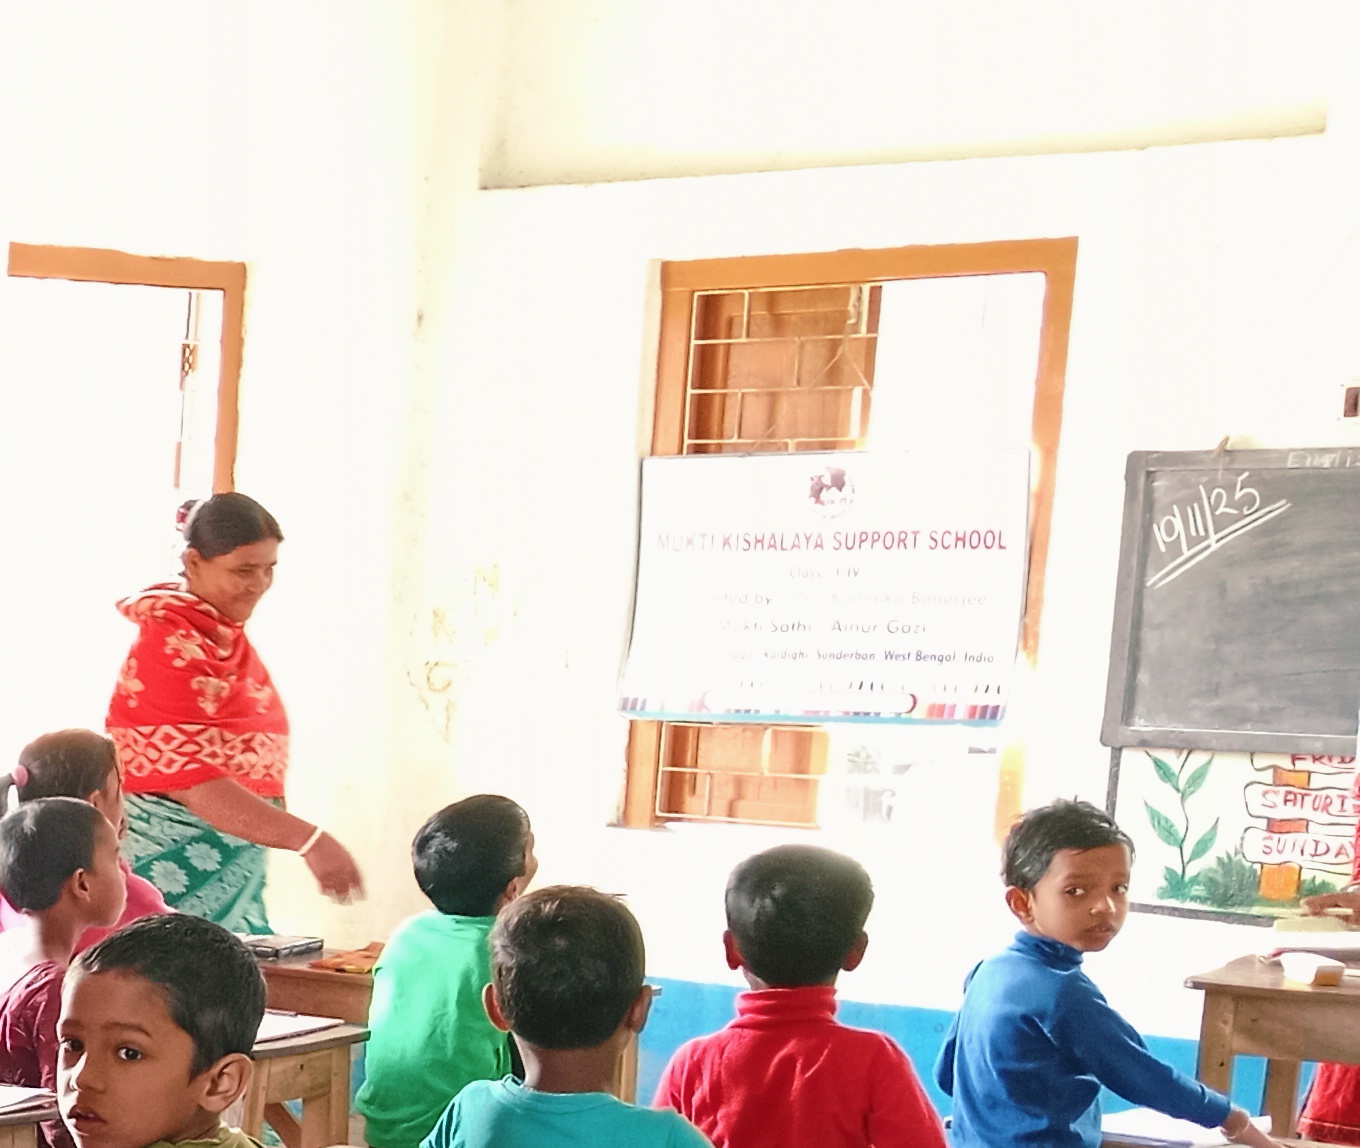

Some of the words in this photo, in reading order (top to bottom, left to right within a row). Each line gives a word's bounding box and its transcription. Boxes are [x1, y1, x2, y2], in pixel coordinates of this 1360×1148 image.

[1152, 471, 1260, 554] 10/11/25
[658, 534, 715, 551] MUKTI
[722, 532, 824, 551] KISHALAYA
[832, 531, 920, 550] SUPPORT
[928, 530, 1007, 550] SCHOOL
[883, 649, 911, 661] West
[963, 650, 994, 663] India
